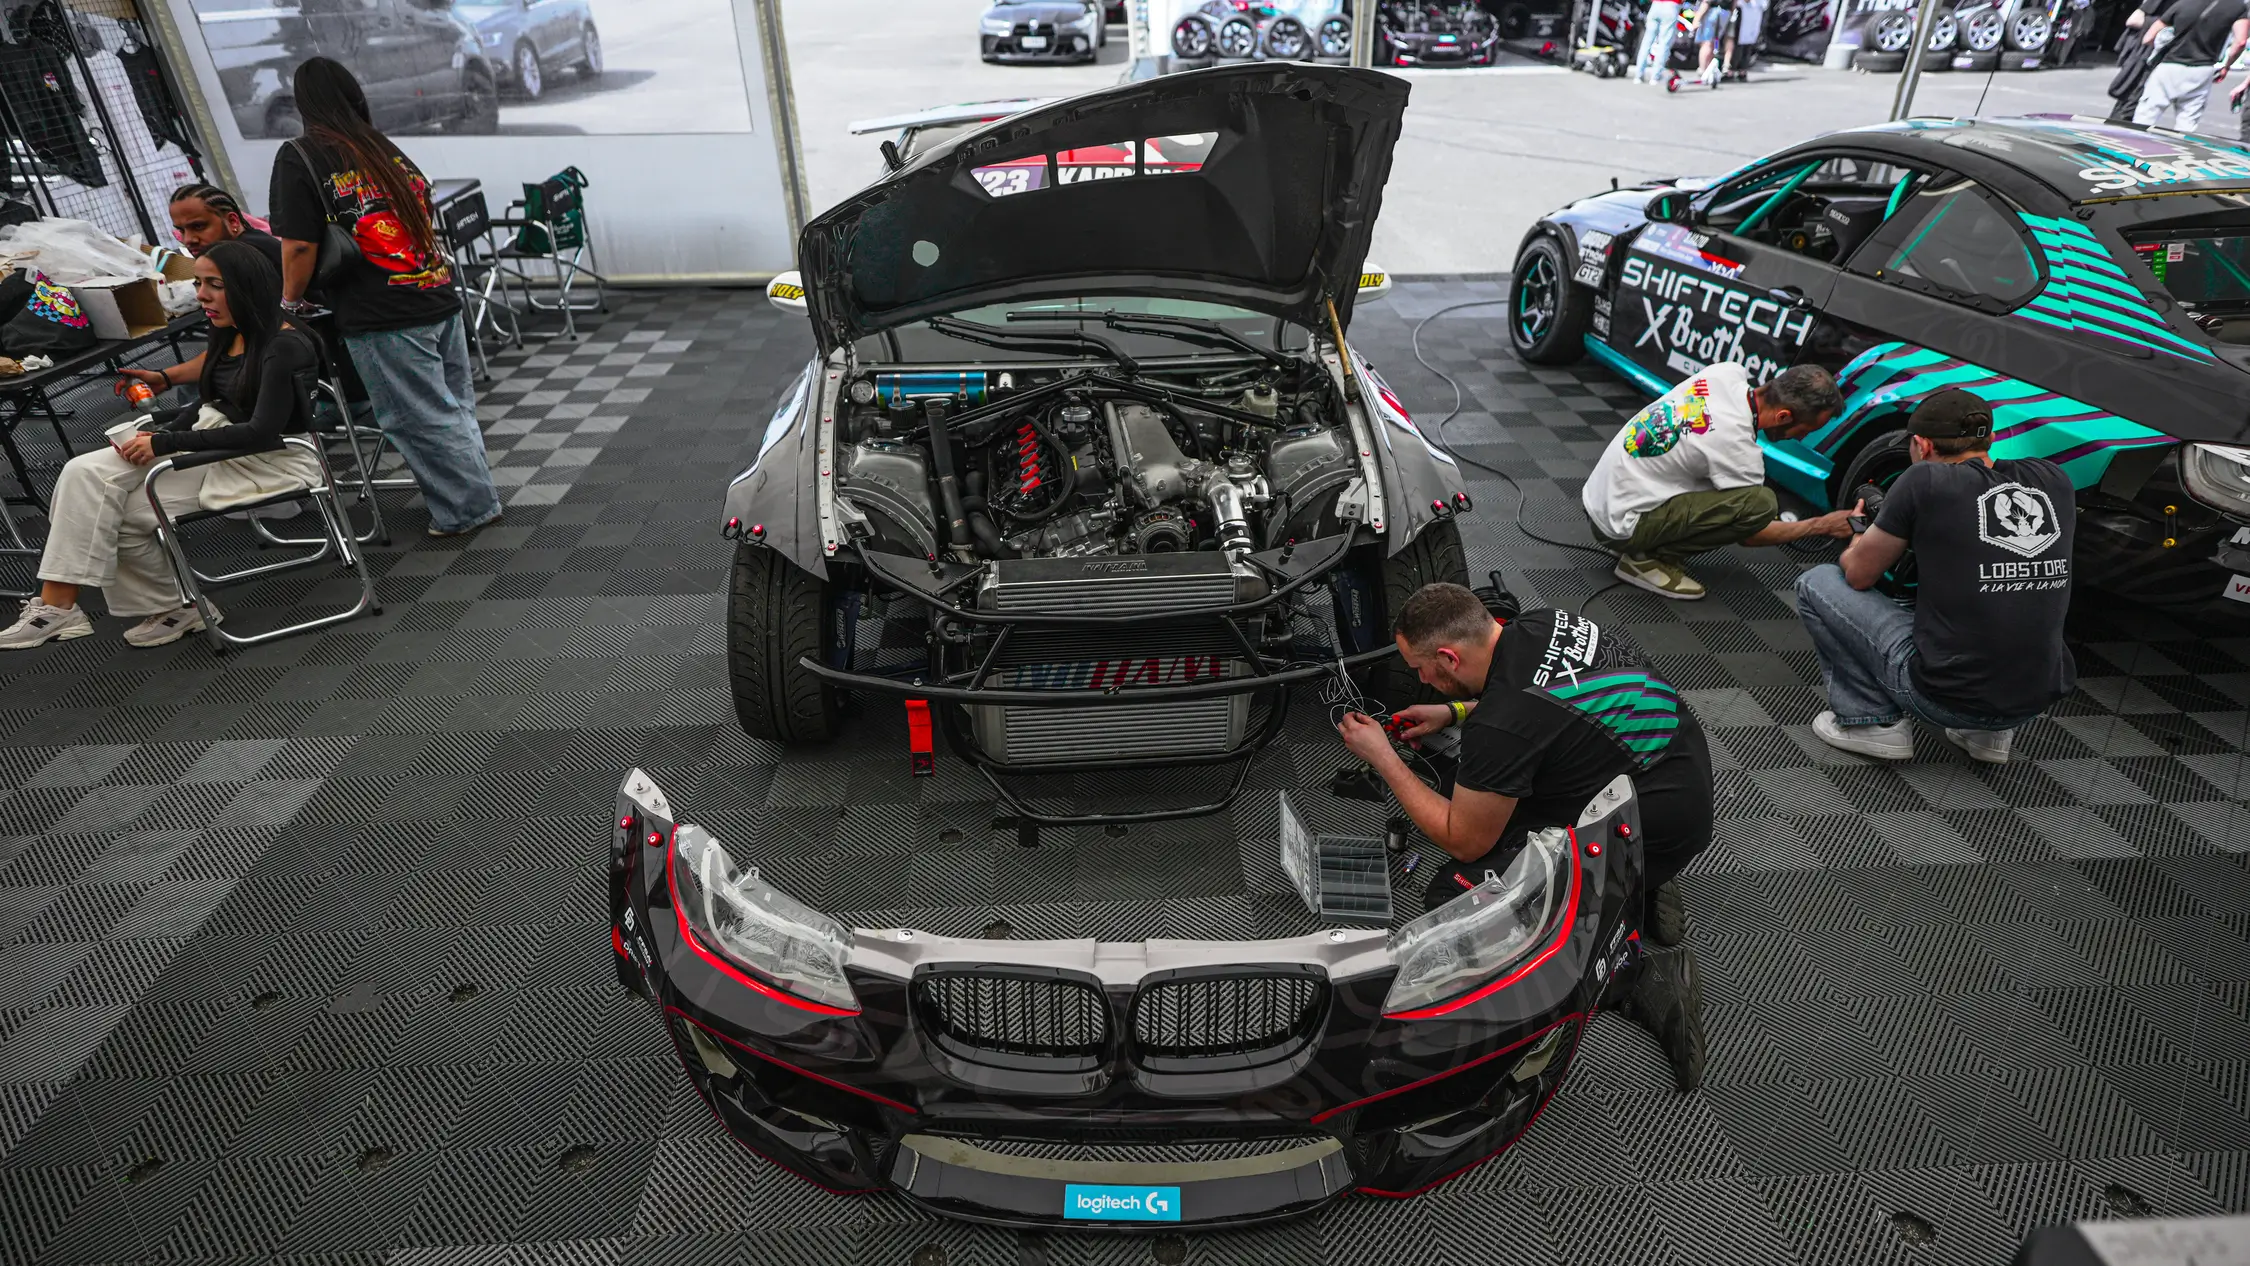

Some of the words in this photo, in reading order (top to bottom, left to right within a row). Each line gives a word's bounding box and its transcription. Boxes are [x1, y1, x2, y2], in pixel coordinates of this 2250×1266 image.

[1359, 273, 1384, 287] OLY
[1621, 257, 1814, 347] SHIFTECH
[1979, 559, 2068, 579] LOBSTORE
[1980, 583, 1989, 593] A
[1991, 583, 2005, 592] LA
[1533, 608, 1569, 688] SHIFTECH
[1077, 1194, 1141, 1213] logitech
